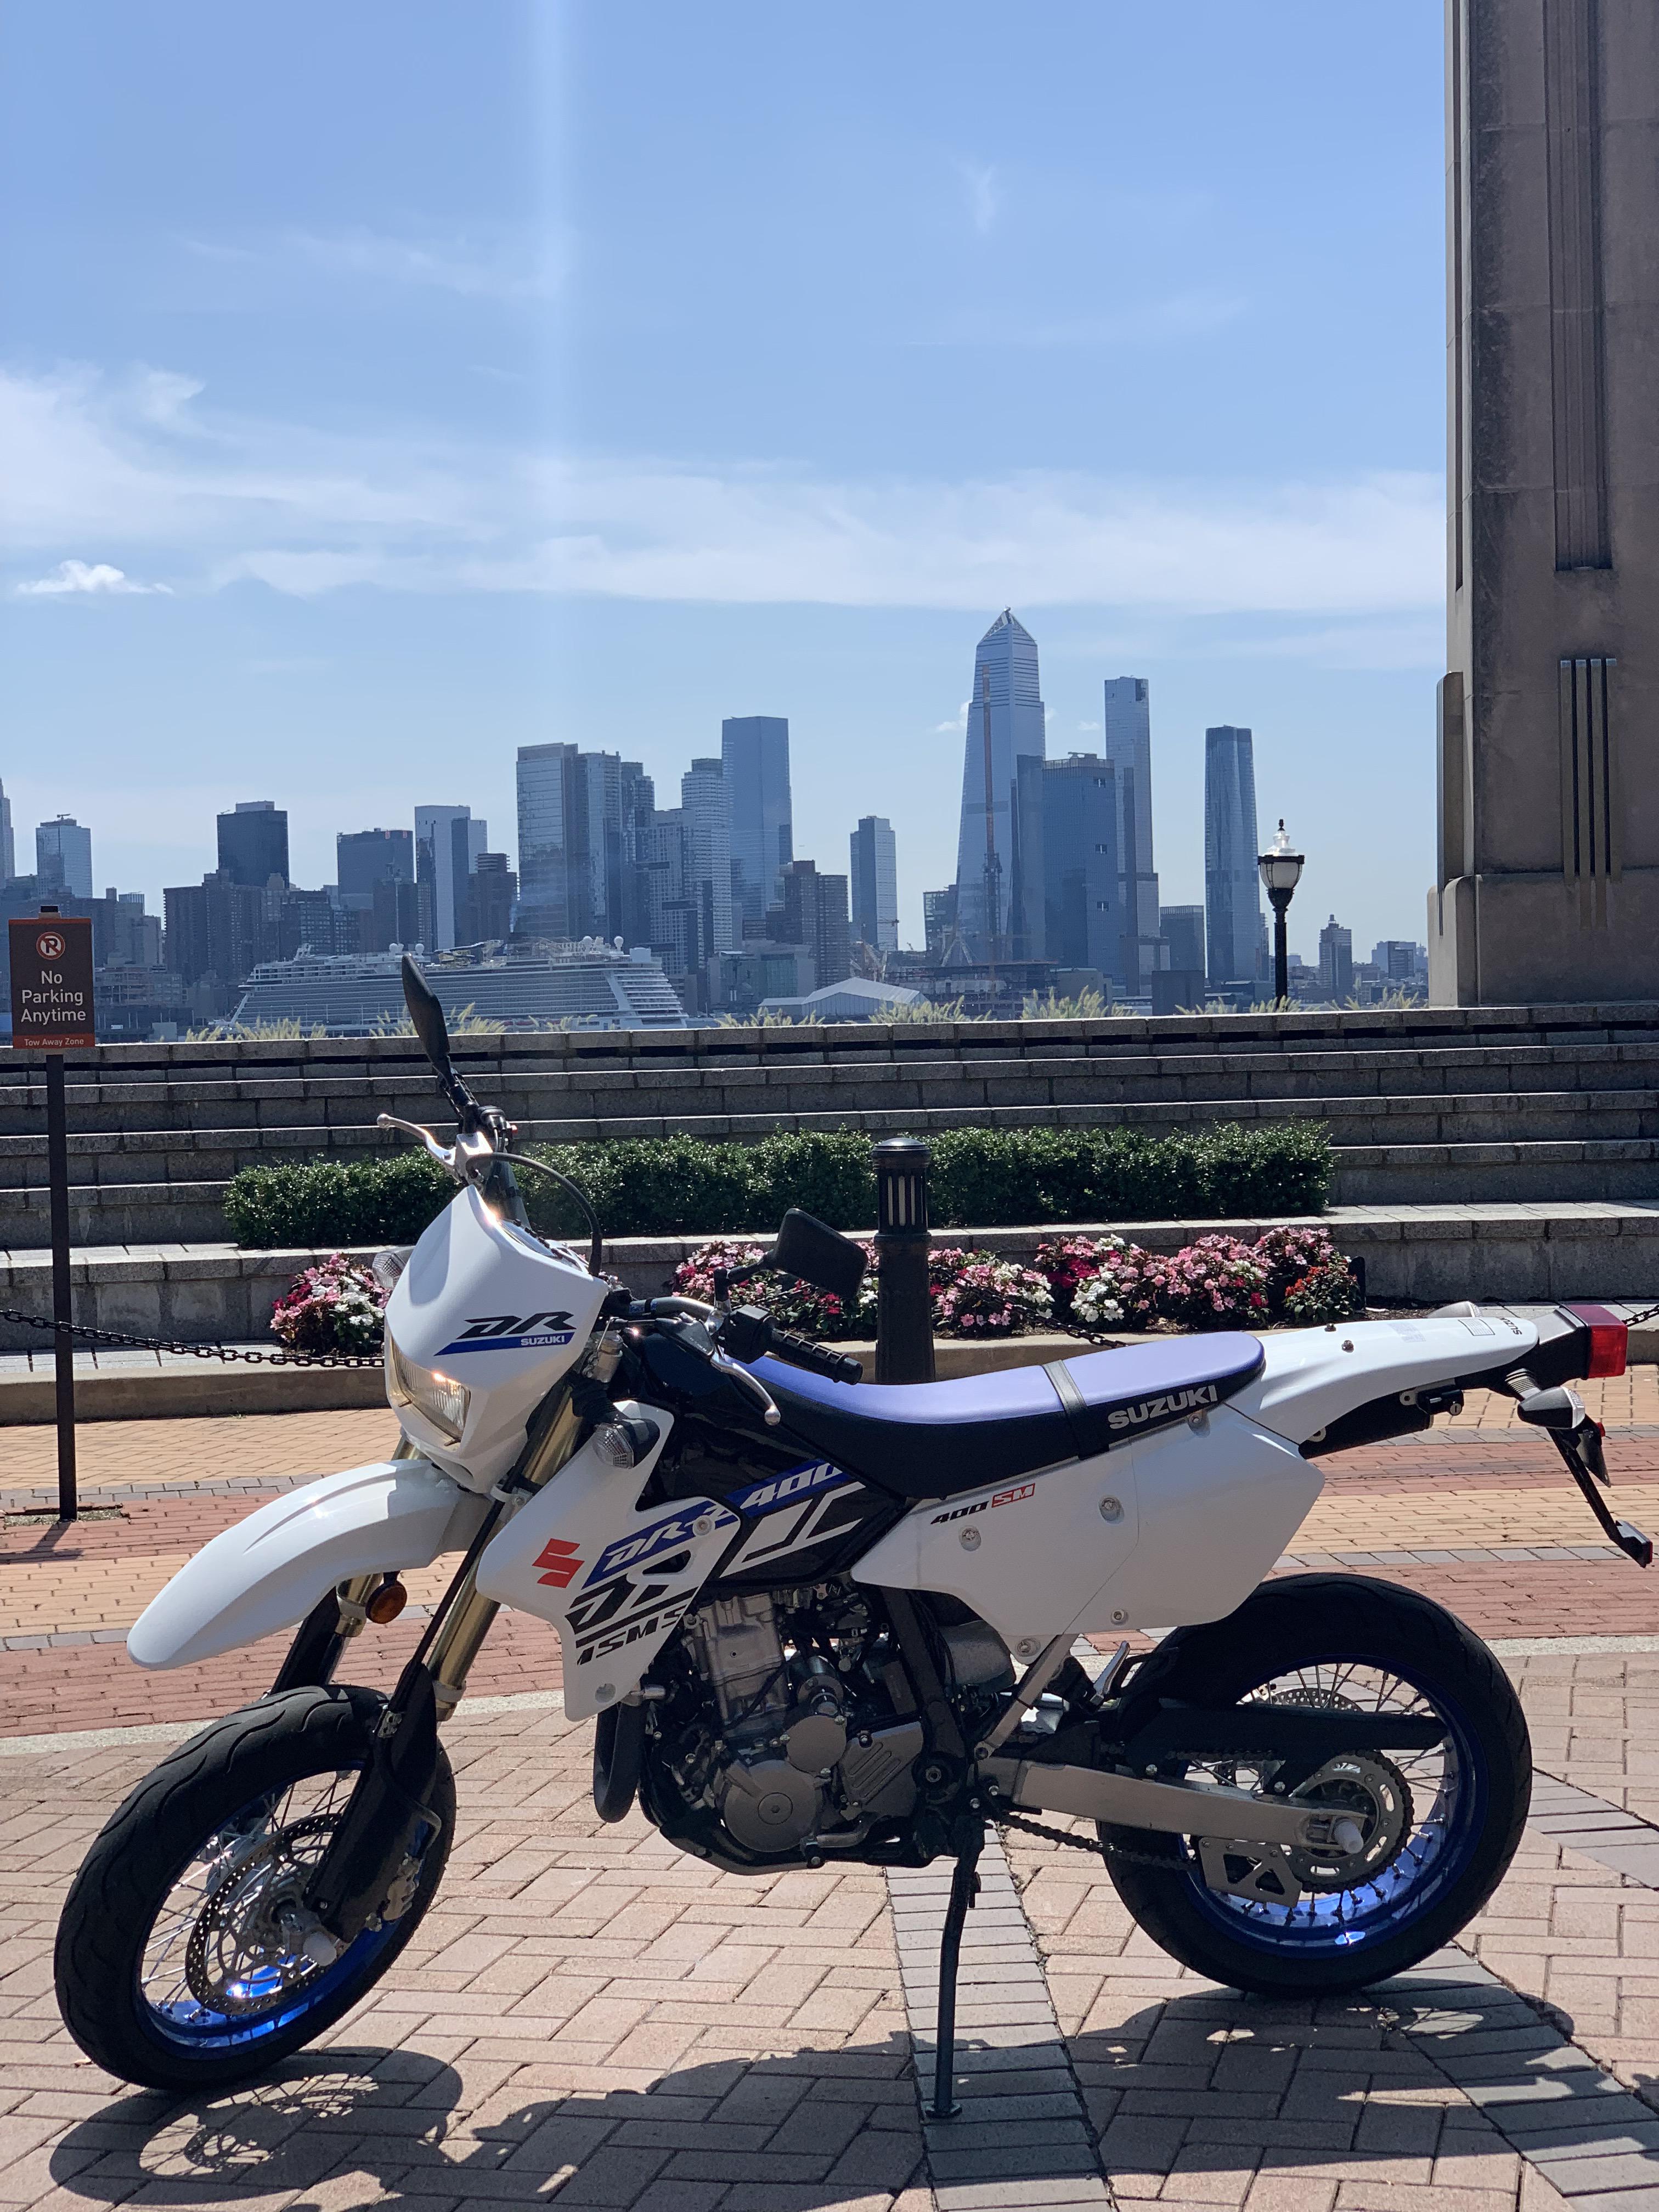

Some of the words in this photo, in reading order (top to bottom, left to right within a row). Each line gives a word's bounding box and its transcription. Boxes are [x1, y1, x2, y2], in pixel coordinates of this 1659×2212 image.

[41, 970, 63, 984] No
[22, 989, 83, 1006] Parking
[21, 1008, 86, 1025] Anytime
[42, 1038, 63, 1047] Away
[456, 1311, 577, 1339] DR
[521, 1335, 565, 1346] SUZUKI
[1108, 1385, 1218, 1429] SUZUKI
[930, 1500, 989, 1524] 400
[993, 1485, 1034, 1506] SM
